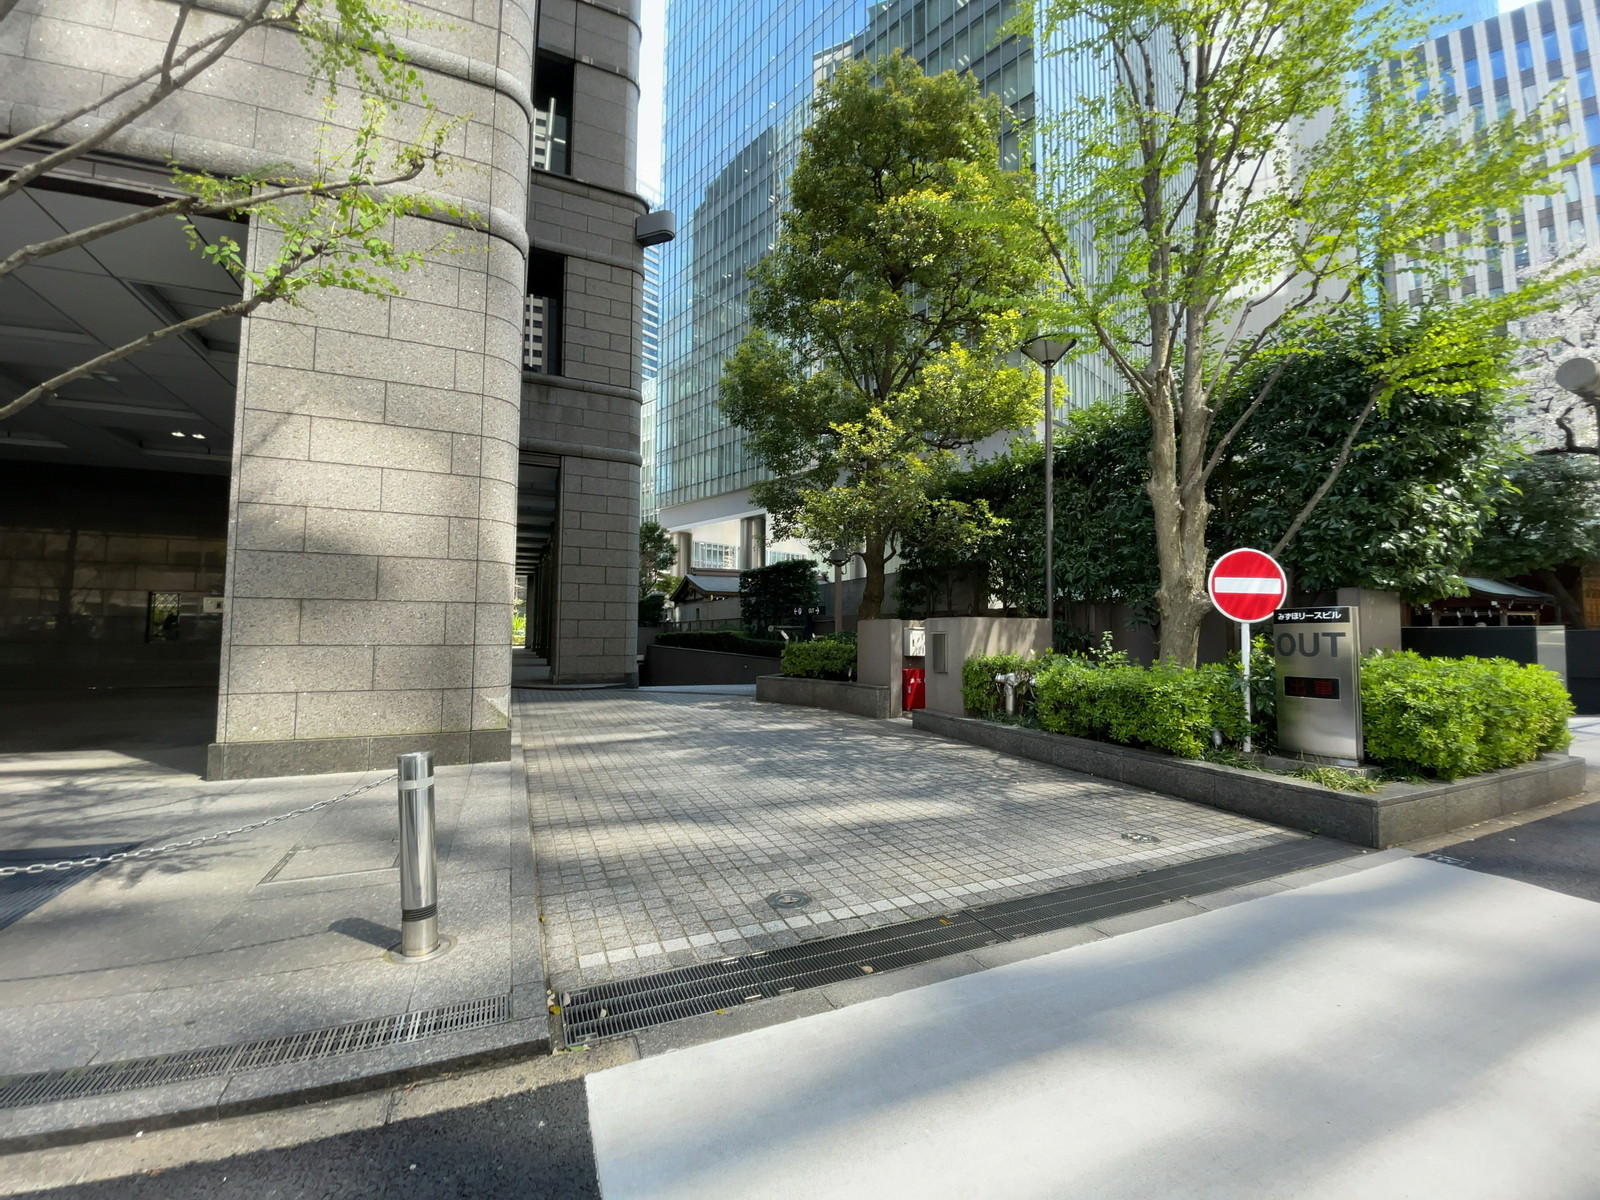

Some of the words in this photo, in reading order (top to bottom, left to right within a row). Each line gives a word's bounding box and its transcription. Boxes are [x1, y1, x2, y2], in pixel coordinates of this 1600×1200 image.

[1277, 611, 1342, 620] みずほリースビル
[1277, 632, 1346, 657] OUT
